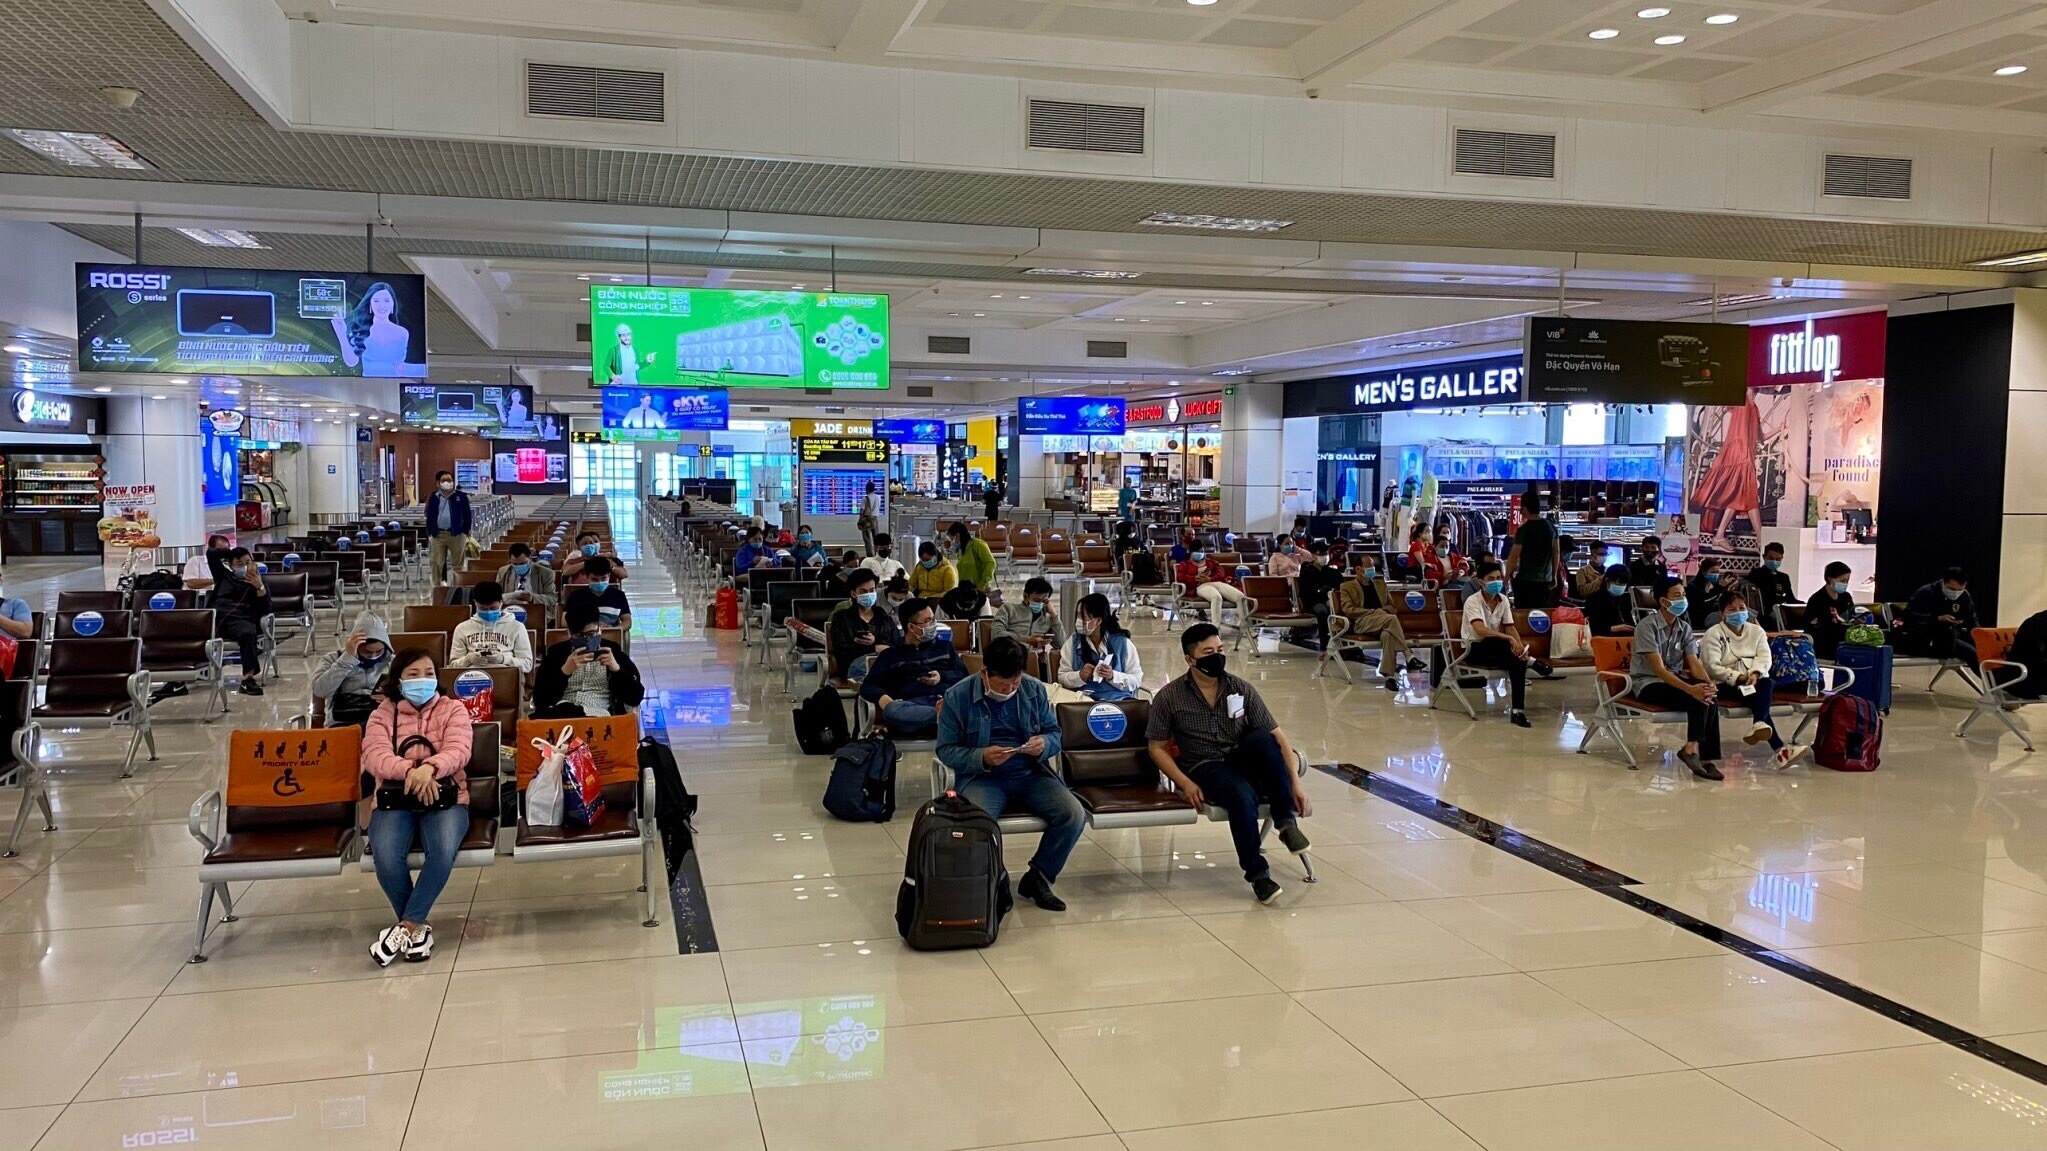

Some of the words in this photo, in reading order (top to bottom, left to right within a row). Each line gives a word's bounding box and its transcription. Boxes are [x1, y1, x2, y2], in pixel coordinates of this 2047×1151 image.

[90, 273, 167, 290] ROSSI
[598, 287, 626, 299] BỒN
[598, 301, 628, 310] CÔNG
[1547, 331, 1561, 339] VIB
[1771, 319, 1840, 384] fitflop
[1545, 360, 1562, 371] Đặc
[1562, 360, 1590, 372] Quyền
[1591, 362, 1602, 371] Vô
[1604, 362, 1620, 373] Hạn
[1354, 372, 1415, 406] MEN'S
[673, 395, 709, 408] eKYC
[1134, 406, 1163, 420] FASTFOOD
[1184, 402, 1205, 416] LUCKY
[813, 423, 842, 434] JADE
[848, 426, 874, 434] DRINK
[700, 446, 710, 456] 12
[1832, 469, 1869, 482] found
[105, 486, 128, 496] NOW
[131, 484, 155, 494] OPEN
[467, 632, 479, 644] THE
